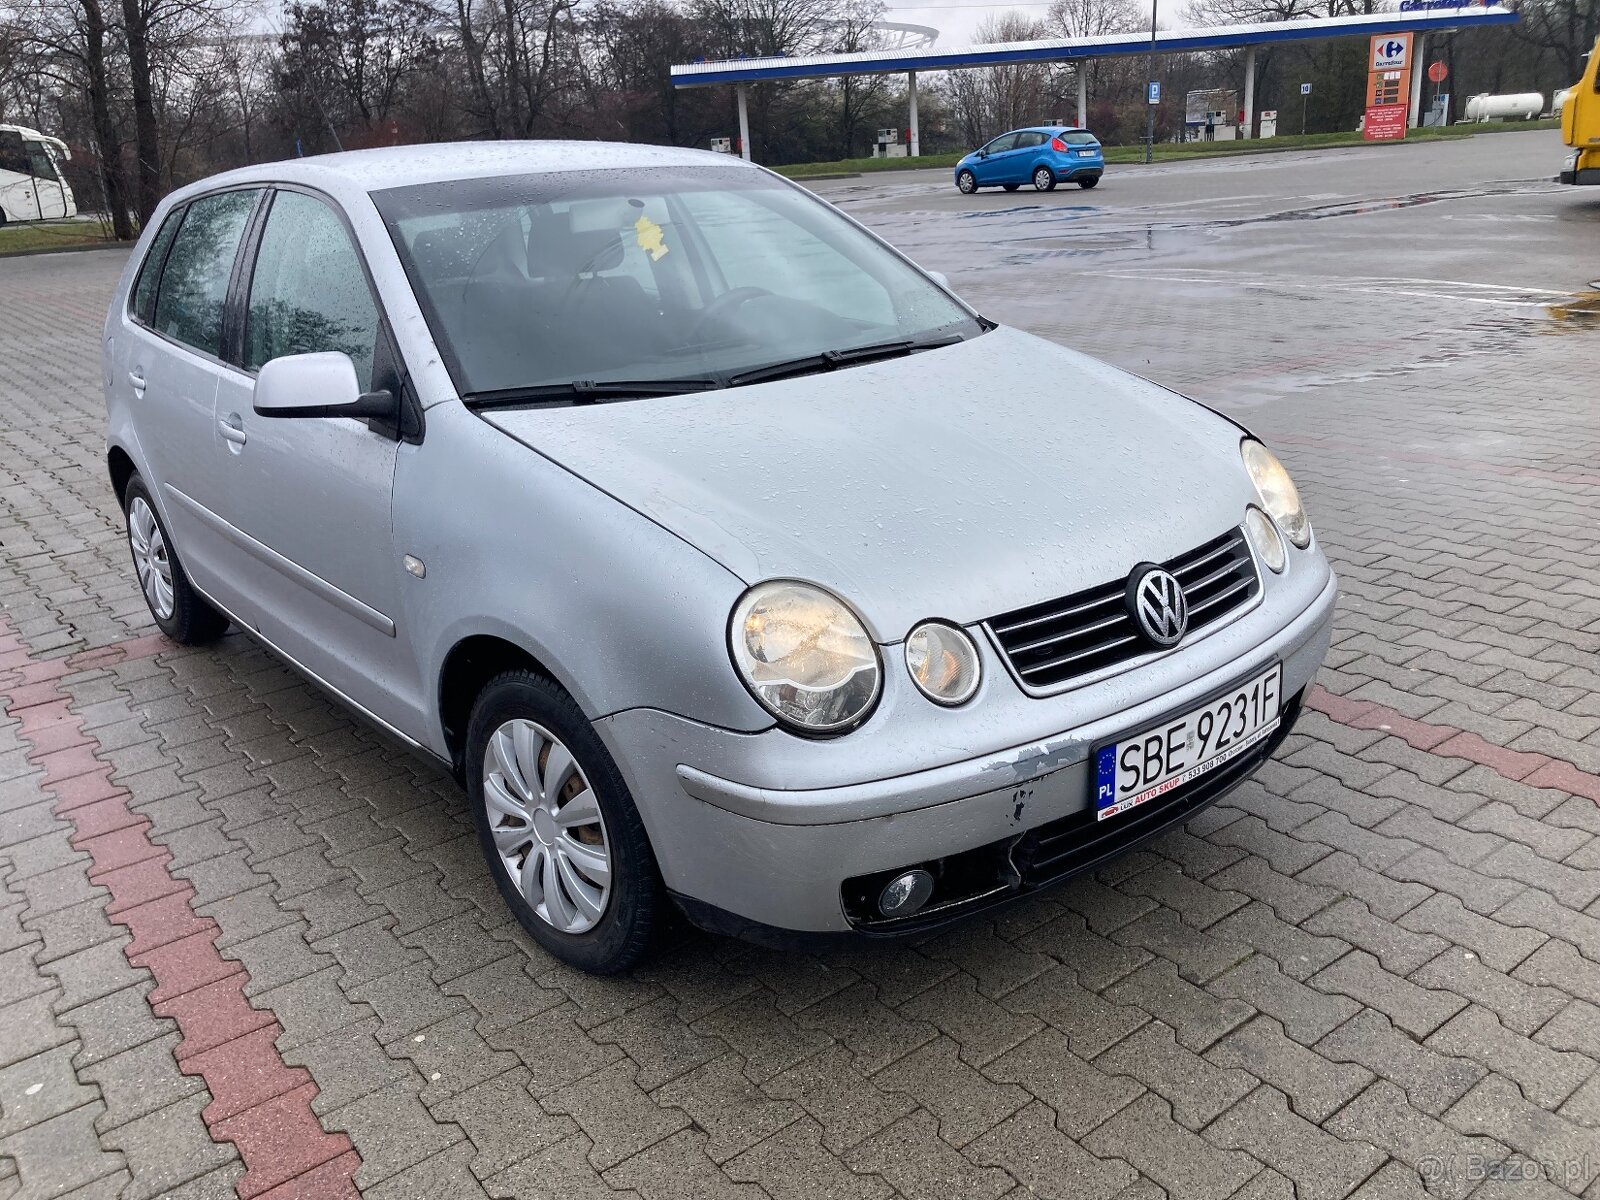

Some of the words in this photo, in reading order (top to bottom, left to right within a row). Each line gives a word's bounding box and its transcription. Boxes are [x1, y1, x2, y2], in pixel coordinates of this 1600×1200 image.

[1151, 84, 1159, 99] P
[1301, 85, 1309, 93] 10
[1120, 721, 1187, 793] SBE
[1197, 671, 1277, 760] 9231F
[1134, 788, 1157, 805] AUTO
[1159, 777, 1180, 794] SKUP
[1188, 768, 1201, 780] 533
[1201, 760, 1214, 773] 908
[1215, 753, 1227, 765] 700
[1099, 783, 1113, 800] PL
